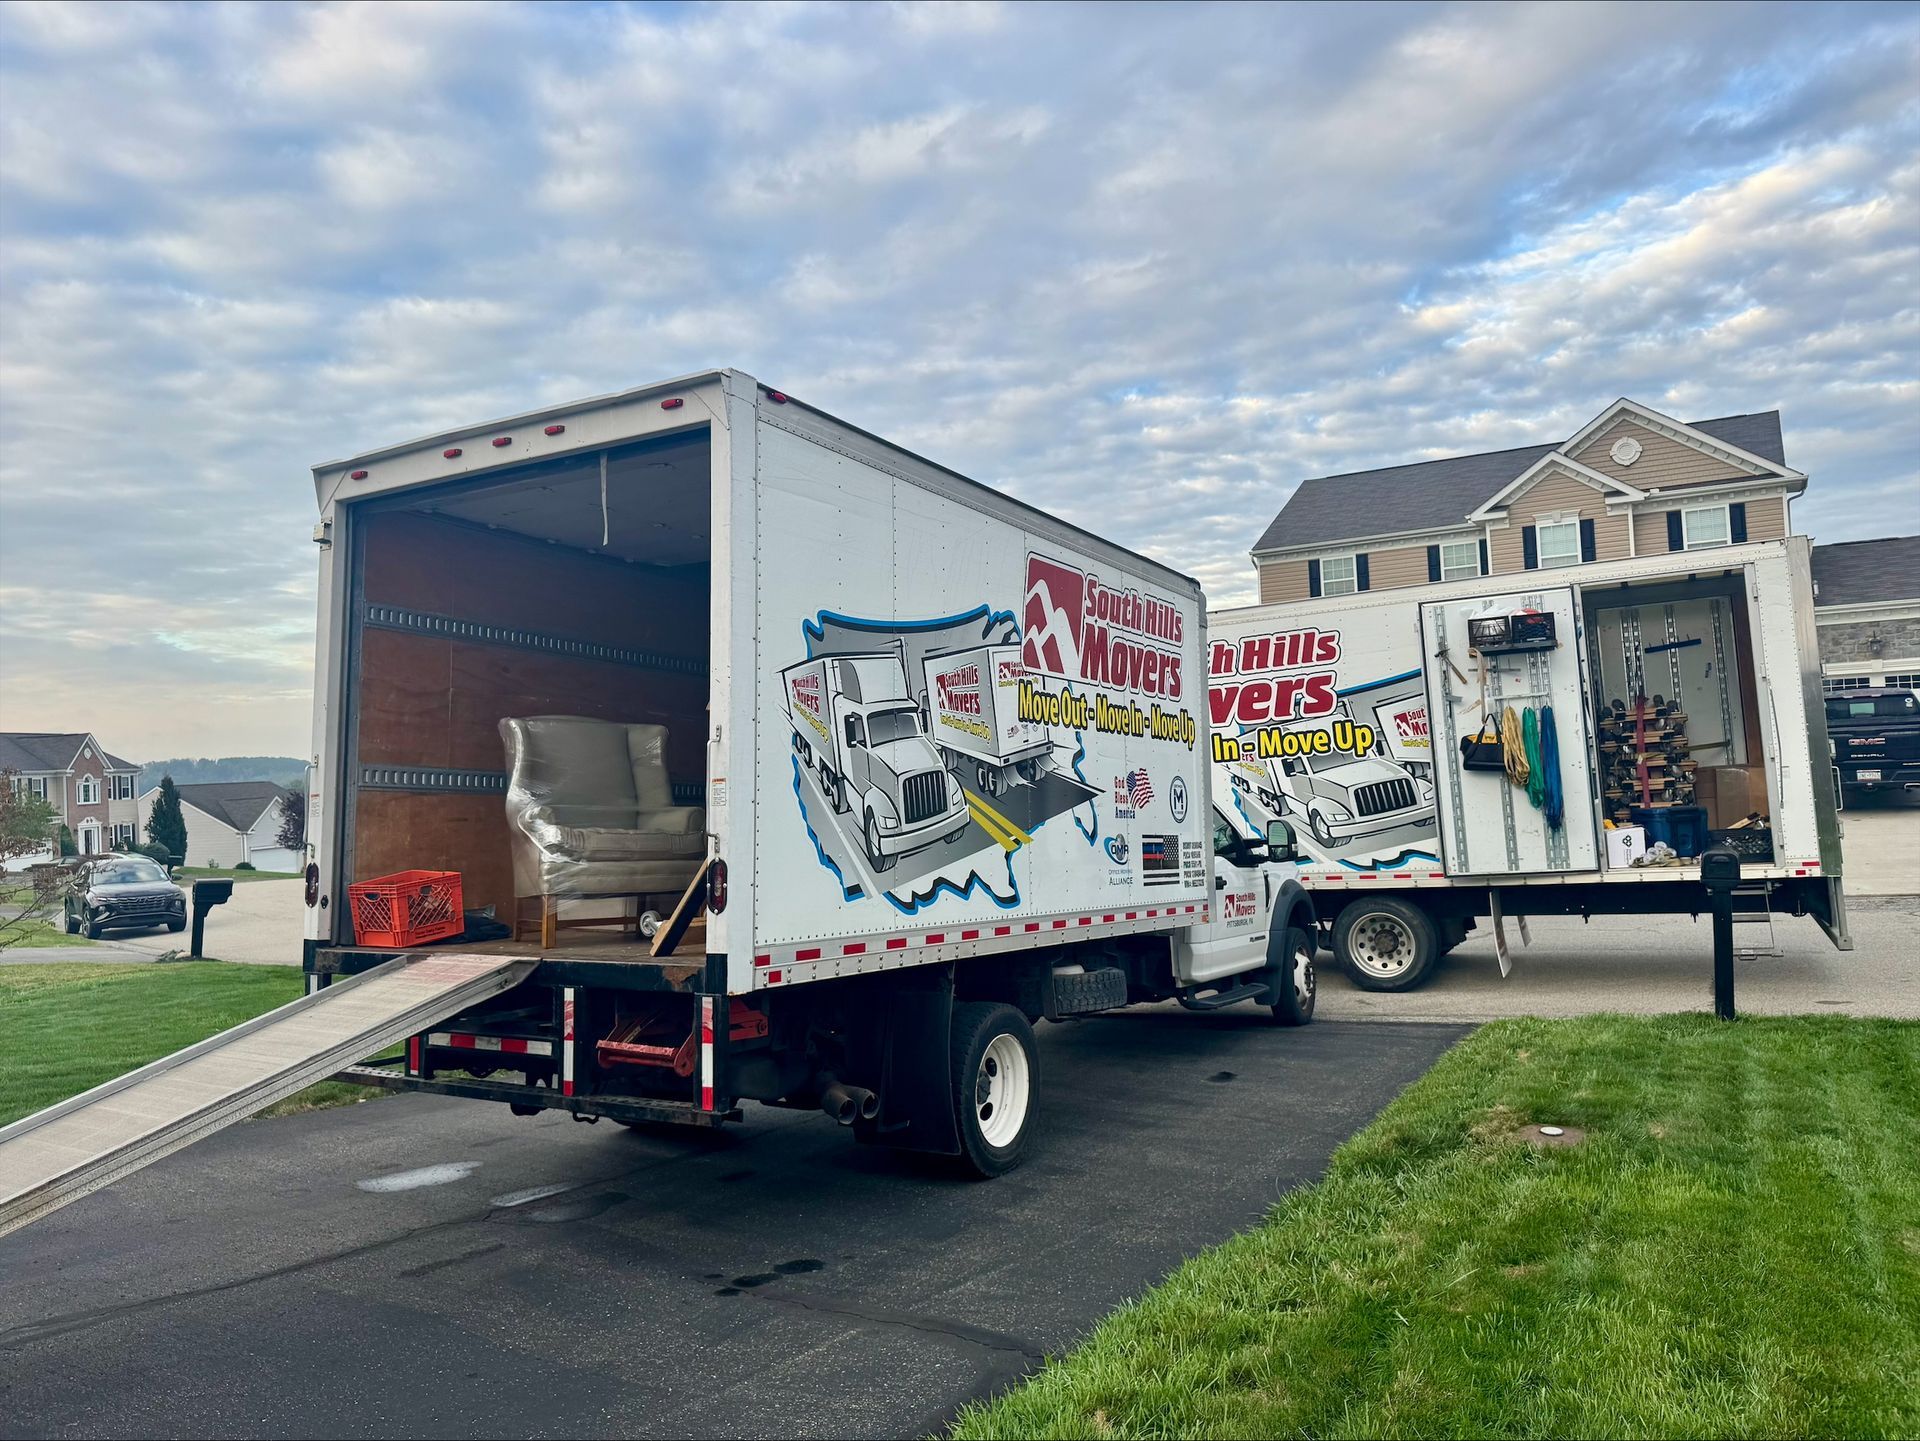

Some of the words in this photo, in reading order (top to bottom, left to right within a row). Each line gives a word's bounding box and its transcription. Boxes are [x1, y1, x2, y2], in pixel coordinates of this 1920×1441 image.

[1085, 578, 1143, 632] South
[1144, 597, 1183, 644] Hills
[1081, 622, 1182, 698] Movers
[1241, 631, 1337, 671] Hills
[960, 664, 979, 686] Hills
[947, 689, 980, 715] Movers
[1208, 674, 1334, 724] vers
[1019, 679, 1060, 727] Move
[1061, 687, 1088, 731] Out
[1096, 693, 1130, 736] Move
[1130, 700, 1144, 737] In
[1151, 704, 1180, 741] Move
[1180, 709, 1196, 751] Up
[1407, 708, 1426, 721] Sout
[1212, 733, 1239, 762] In
[1257, 727, 1332, 760] Move
[1332, 720, 1375, 758] Up
[1848, 738, 1886, 746] GMC
[1114, 776, 1125, 789] God
[1115, 791, 1129, 805] Bless
[1115, 806, 1136, 819] America
[1235, 904, 1256, 917] Movers
